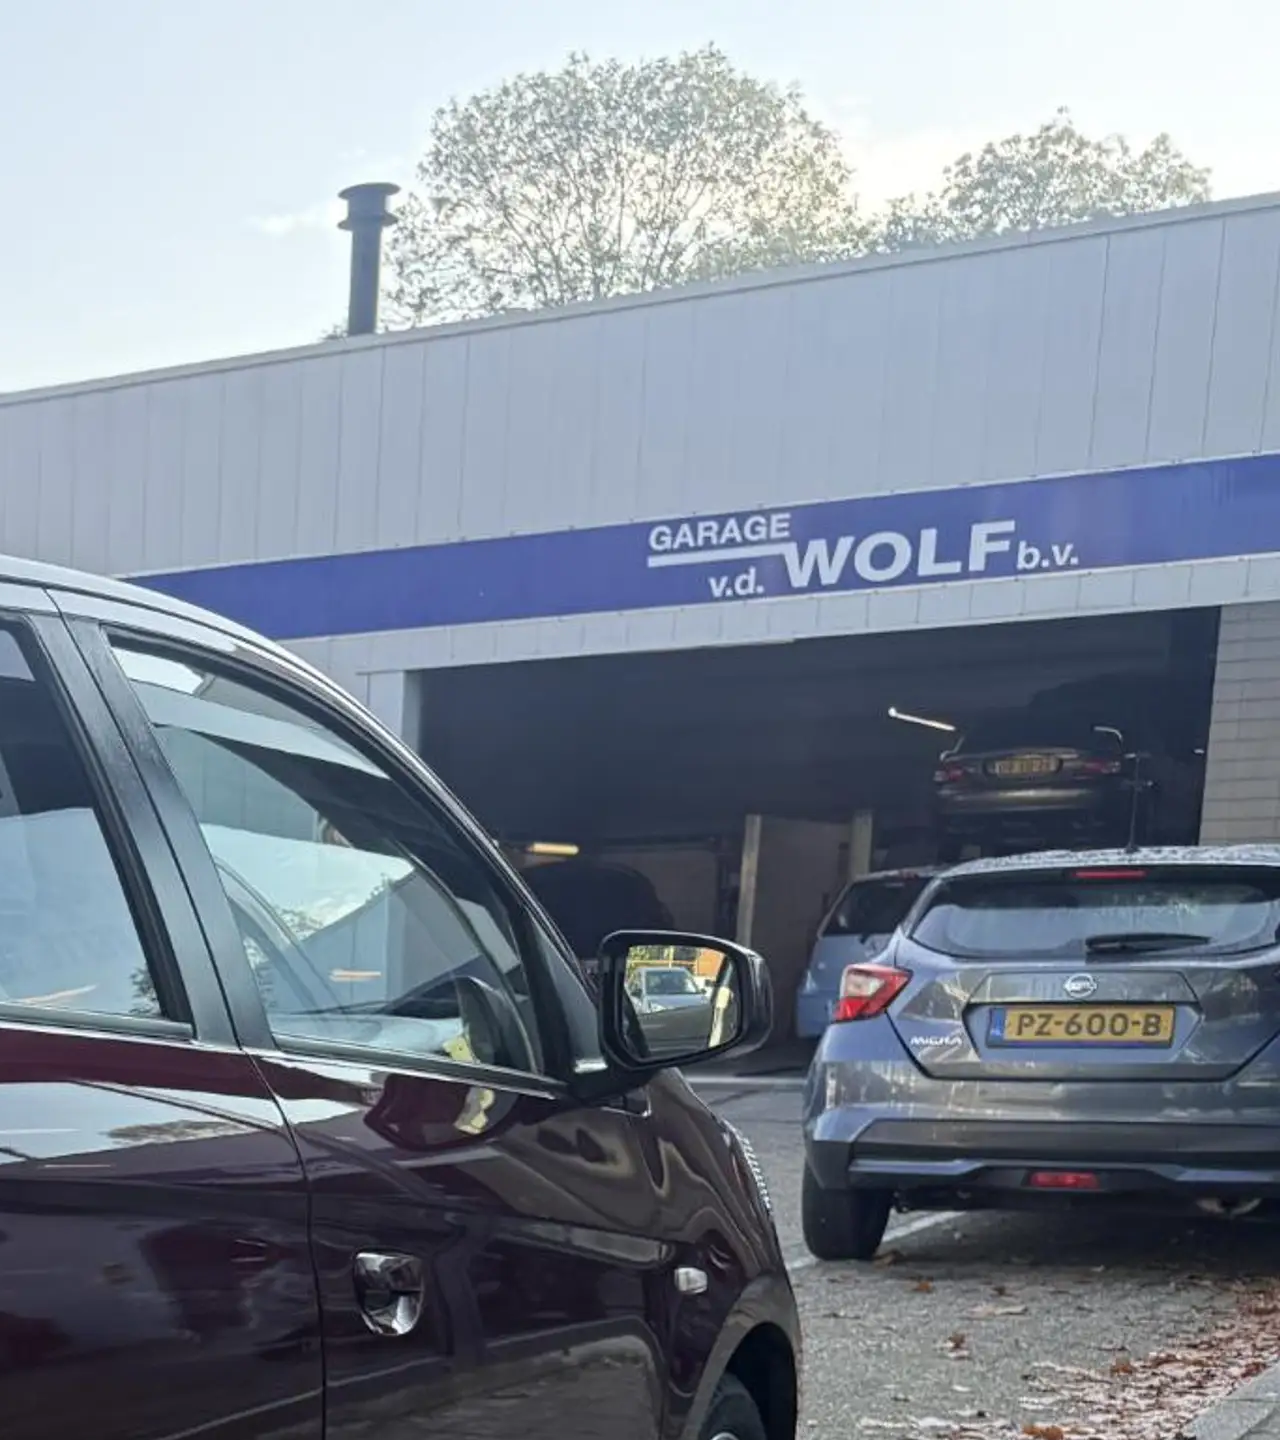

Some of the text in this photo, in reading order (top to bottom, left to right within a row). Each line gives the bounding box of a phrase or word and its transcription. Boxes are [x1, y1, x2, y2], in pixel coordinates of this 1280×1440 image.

[648, 513, 791, 551] GARAGE
[708, 520, 1079, 598] v.d. WOLF b.v.
[1016, 1012, 1161, 1037] PZ-600-B
